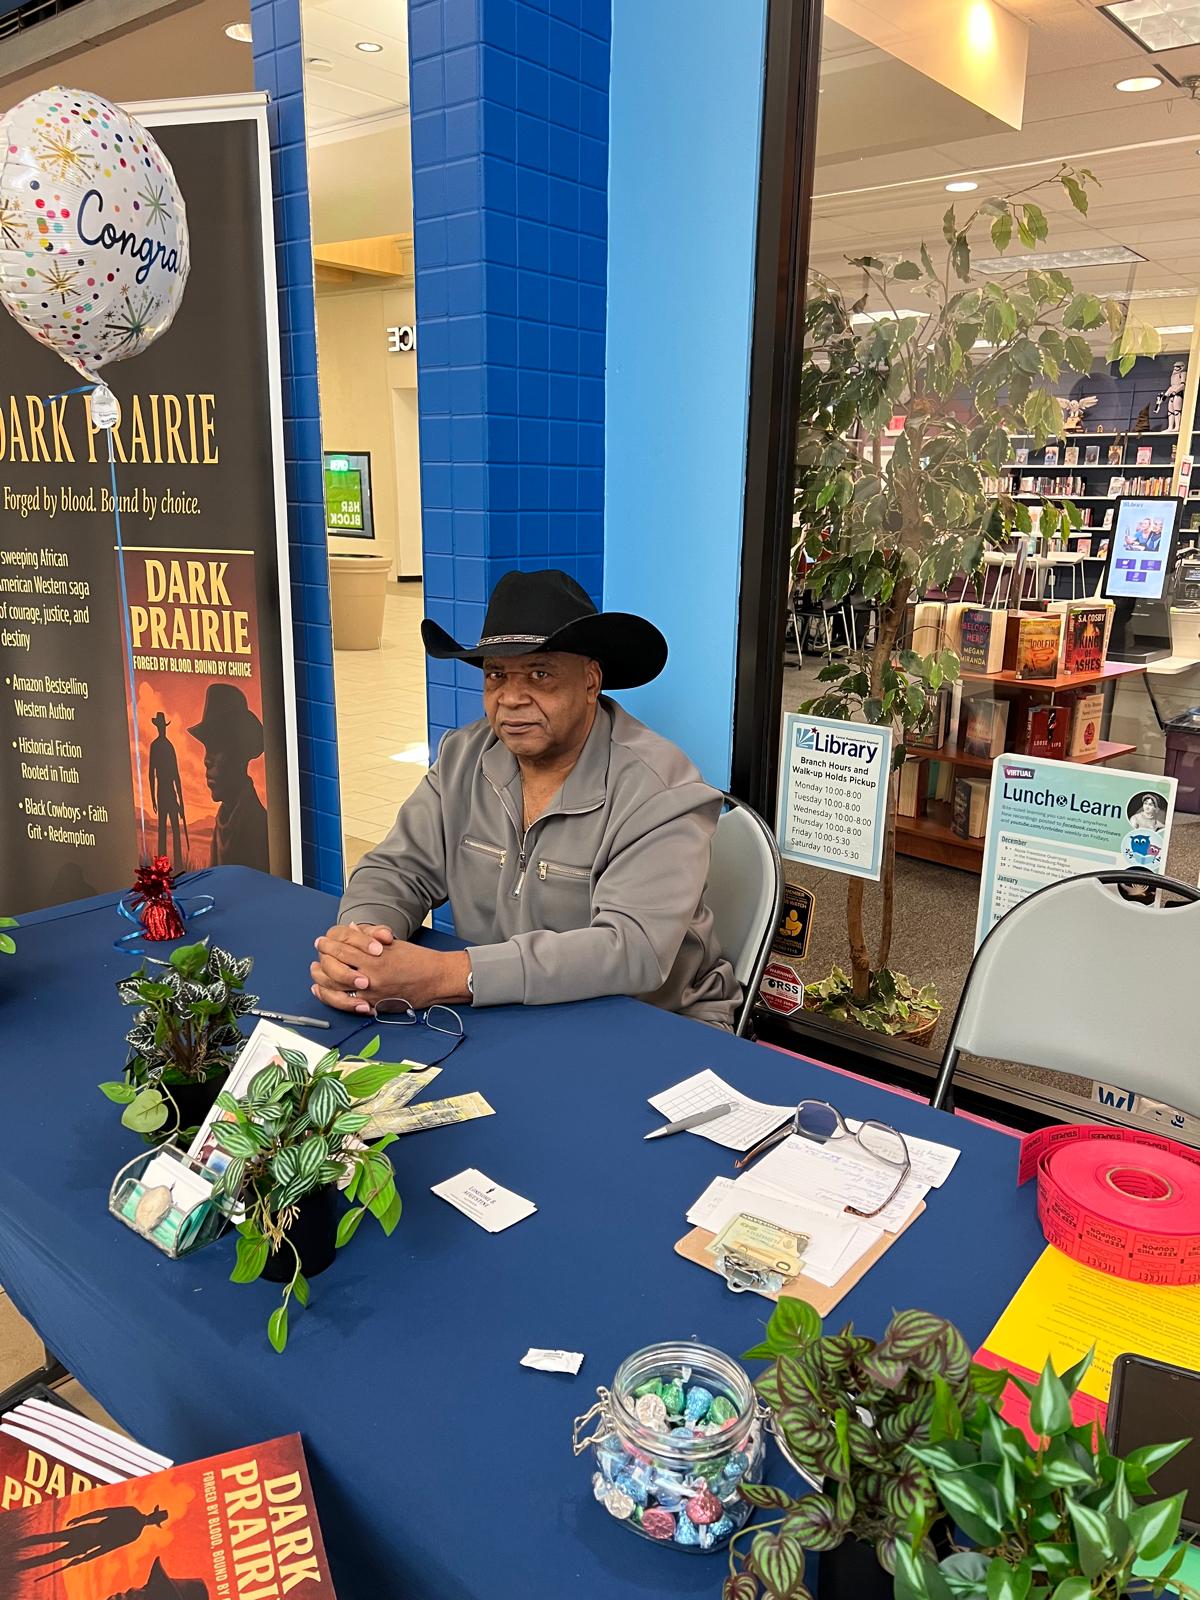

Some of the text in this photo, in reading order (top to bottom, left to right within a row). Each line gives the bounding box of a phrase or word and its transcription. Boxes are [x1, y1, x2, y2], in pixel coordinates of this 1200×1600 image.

[4, 486, 200, 520] Forged by blood. Bound by choice.
[0, 548, 69, 569] sweeping African
[33, 576, 68, 595] Western
[69, 581, 90, 599] saga
[144, 559, 232, 606] DARK
[9, 606, 43, 624] courage,
[43, 603, 72, 626] justice,
[73, 606, 90, 624] and
[1088, 613, 1106, 622] COSBY
[1, 628, 31, 651] destiny
[130, 605, 252, 655] PRAIRIE
[963, 647, 985, 656] MEGAN
[1079, 634, 1099, 649] KING
[132, 655, 159, 670] FORGED
[160, 657, 169, 671] BY
[195, 660, 217, 675] BOUND
[218, 661, 228, 676] BY
[960, 655, 986, 665] MIRANDA
[1074, 659, 1101, 673] ASHES
[13, 674, 89, 699] Amazon Bestselling
[14, 700, 75, 720] Western Author
[18, 737, 82, 758] Historical Fiction
[815, 732, 878, 764] Library
[21, 763, 80, 784] Rooted in Truth
[801, 756, 827, 768] Branch
[829, 762, 852, 773] Hours
[1006, 768, 1033, 778] VIRTUAL
[792, 765, 877, 788] Walk-up Holds Pickup
[794, 780, 823, 793] Monday
[794, 791, 823, 806] Tuesday
[1003, 782, 1055, 808] Lunch
[1070, 793, 1122, 819] Learn
[25, 798, 108, 823] Black Cowboys Faith
[794, 804, 833, 820] Wednesday
[791, 826, 813, 839] Friday
[793, 815, 823, 830] Thursday
[27, 823, 96, 848] Grit Redemption
[791, 838, 821, 852] Saturday
[1001, 835, 1027, 846] December
[997, 875, 1018, 885] January
[1086, 1230, 1126, 1249] KEEP THIS
[1090, 1227, 1122, 1242] COUPON
[1142, 1244, 1175, 1252] COUPON
[1086, 1256, 1116, 1274] TICKET
[1138, 1271, 1168, 1283] TICKET
[24, 1449, 103, 1498] DAR
[203, 1470, 231, 1596] FORGED BY BLOOD. BOUND BY
[221, 1459, 281, 1600] PRAIRI
[264, 1470, 321, 1595] DARK
